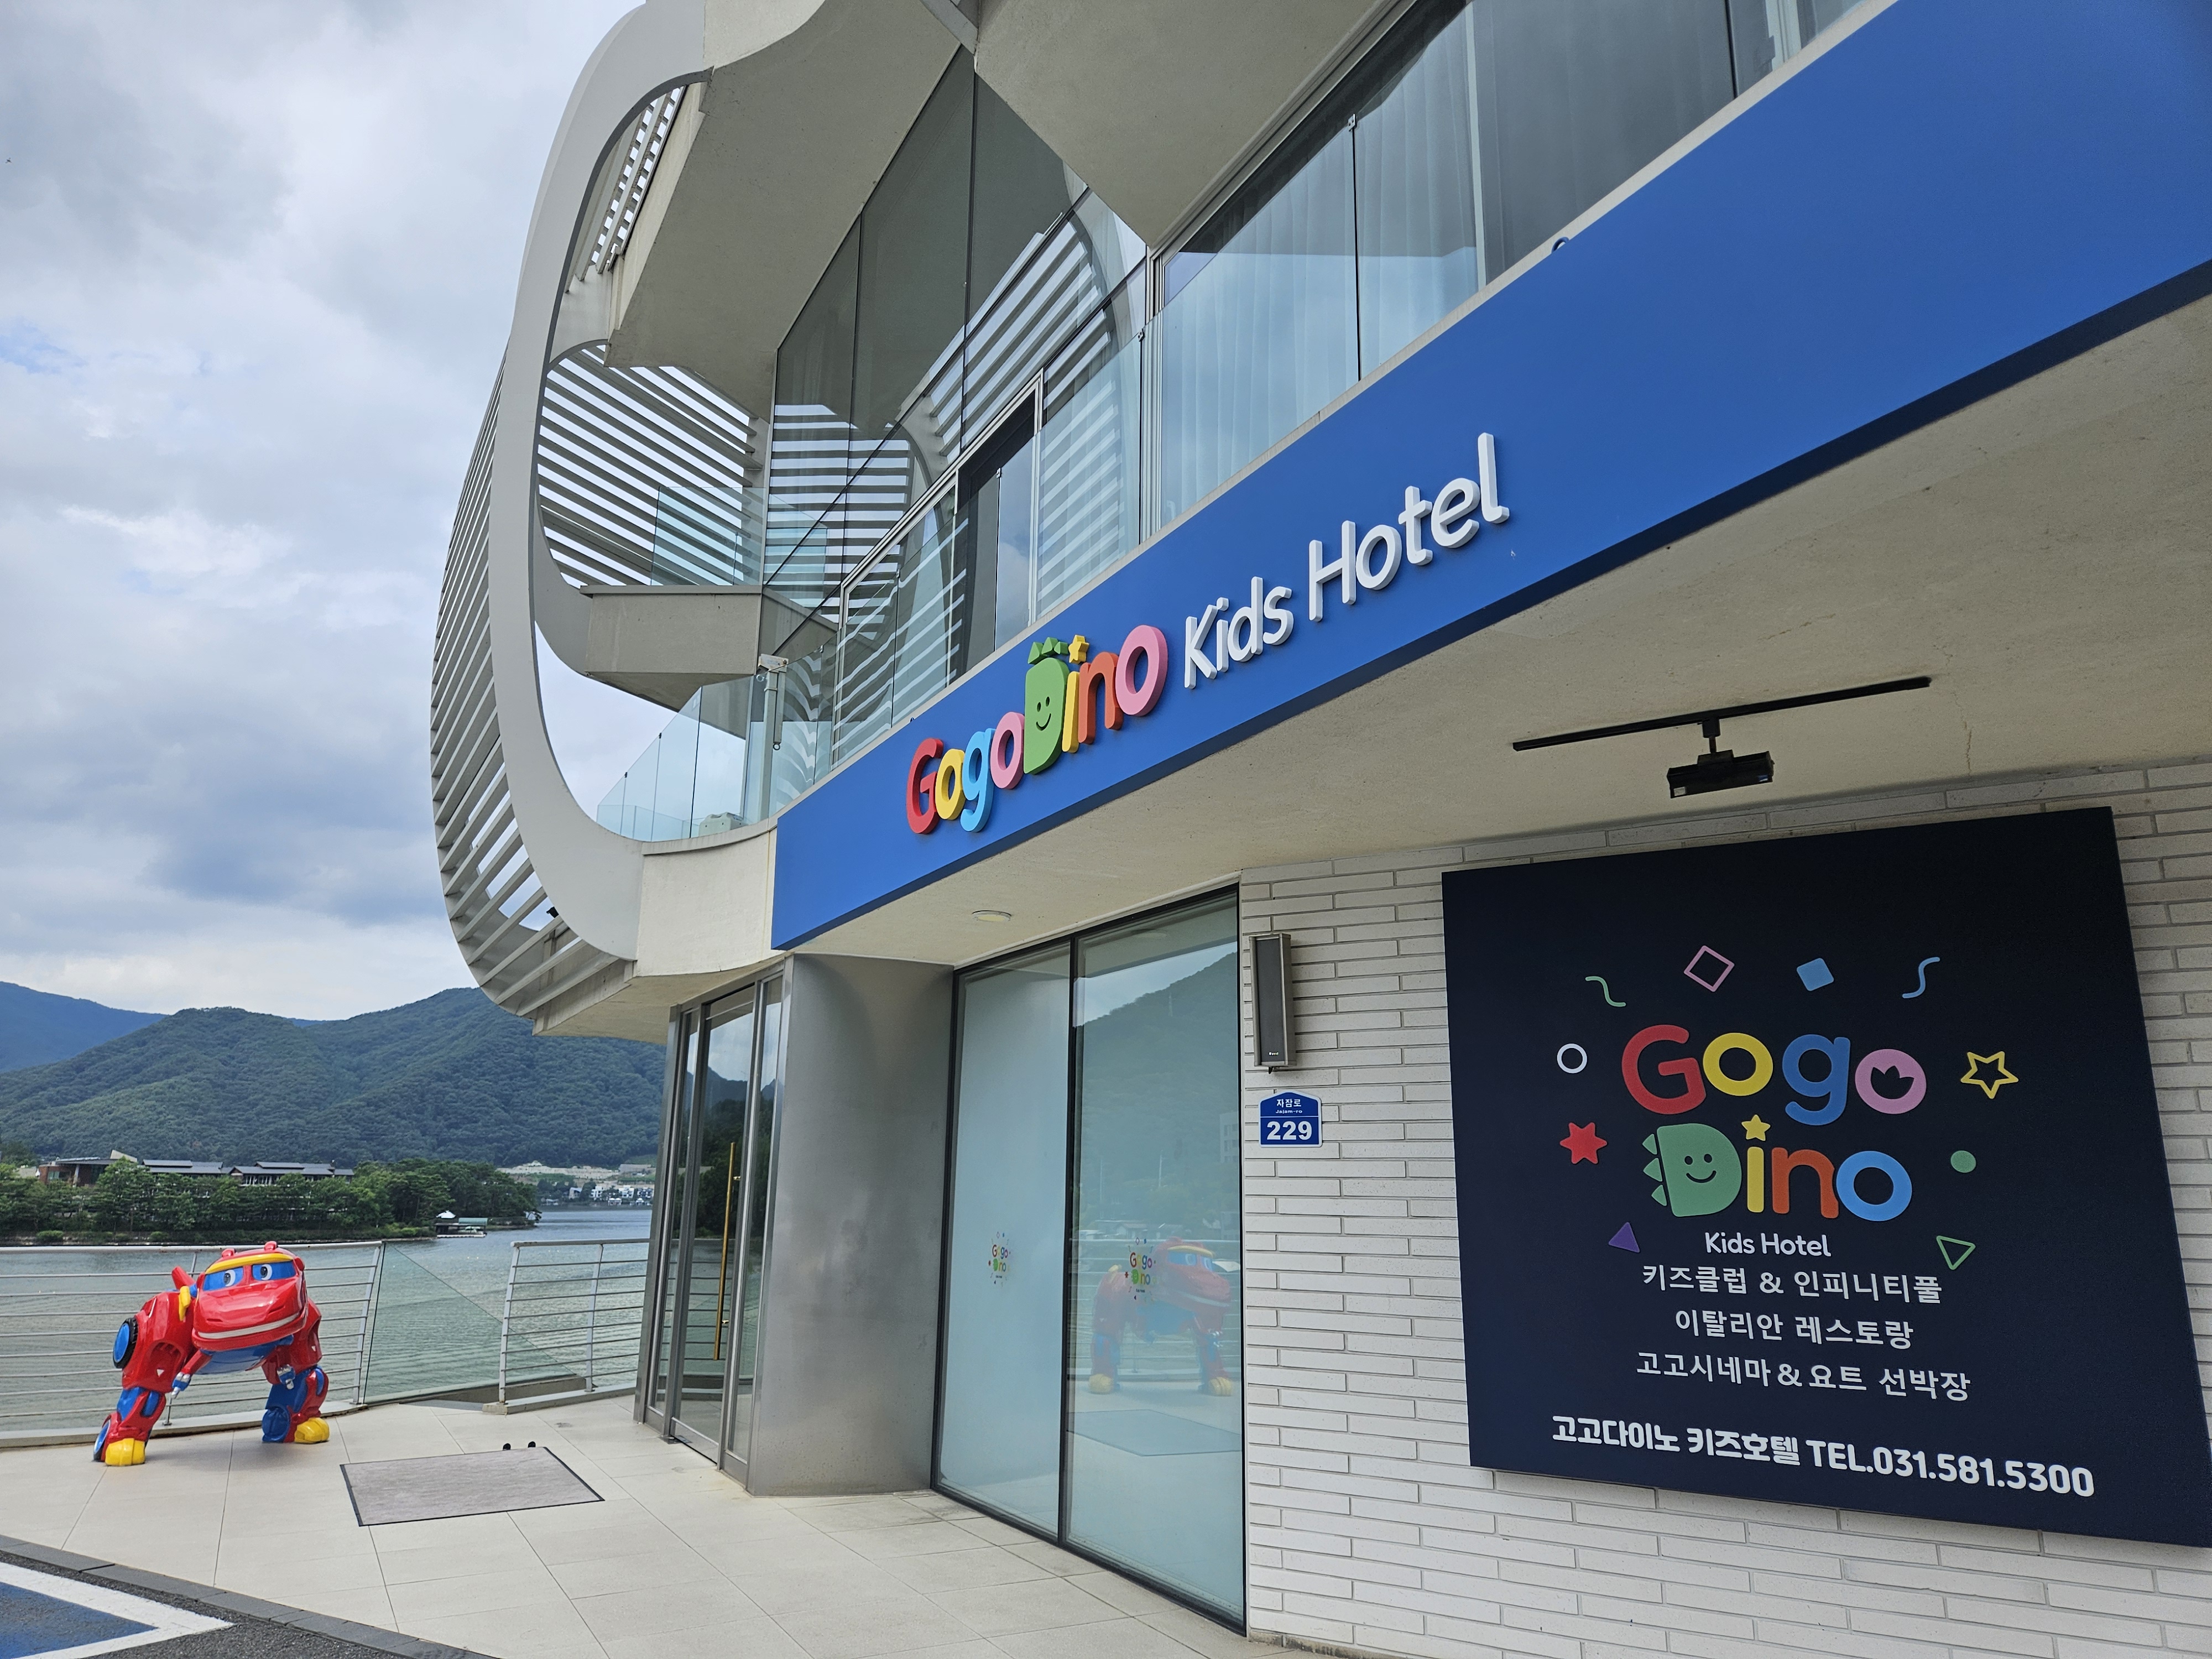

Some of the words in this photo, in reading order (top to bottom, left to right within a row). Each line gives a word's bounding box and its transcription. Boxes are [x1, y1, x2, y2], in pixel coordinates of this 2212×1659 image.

[1183, 576, 1293, 690] Kids
[1308, 432, 1510, 622] Hotel
[1621, 1024, 1927, 1126] Gogo
[1276, 1098, 1302, 1108] 자잠로
[1266, 1121, 1312, 1140] 229
[1642, 1114, 1913, 1222] Dino
[1704, 1232, 1755, 1255] Kids
[1760, 1233, 1832, 1257] Hotel
[1642, 1265, 1747, 1294] 키즈클럽
[1759, 1272, 1784, 1294] &
[1794, 1271, 1943, 1304] 인피니티풀
[1675, 1309, 1783, 1341] 이탈리안
[1794, 1315, 1914, 1349] 레스토랑
[1879, 1368, 1971, 1401] 선박장
[1552, 1415, 1681, 1453] 고고다이노
[1687, 1427, 1801, 1467] 키즈호텔
[1806, 1439, 2095, 1498] TEL.031.581.5300
